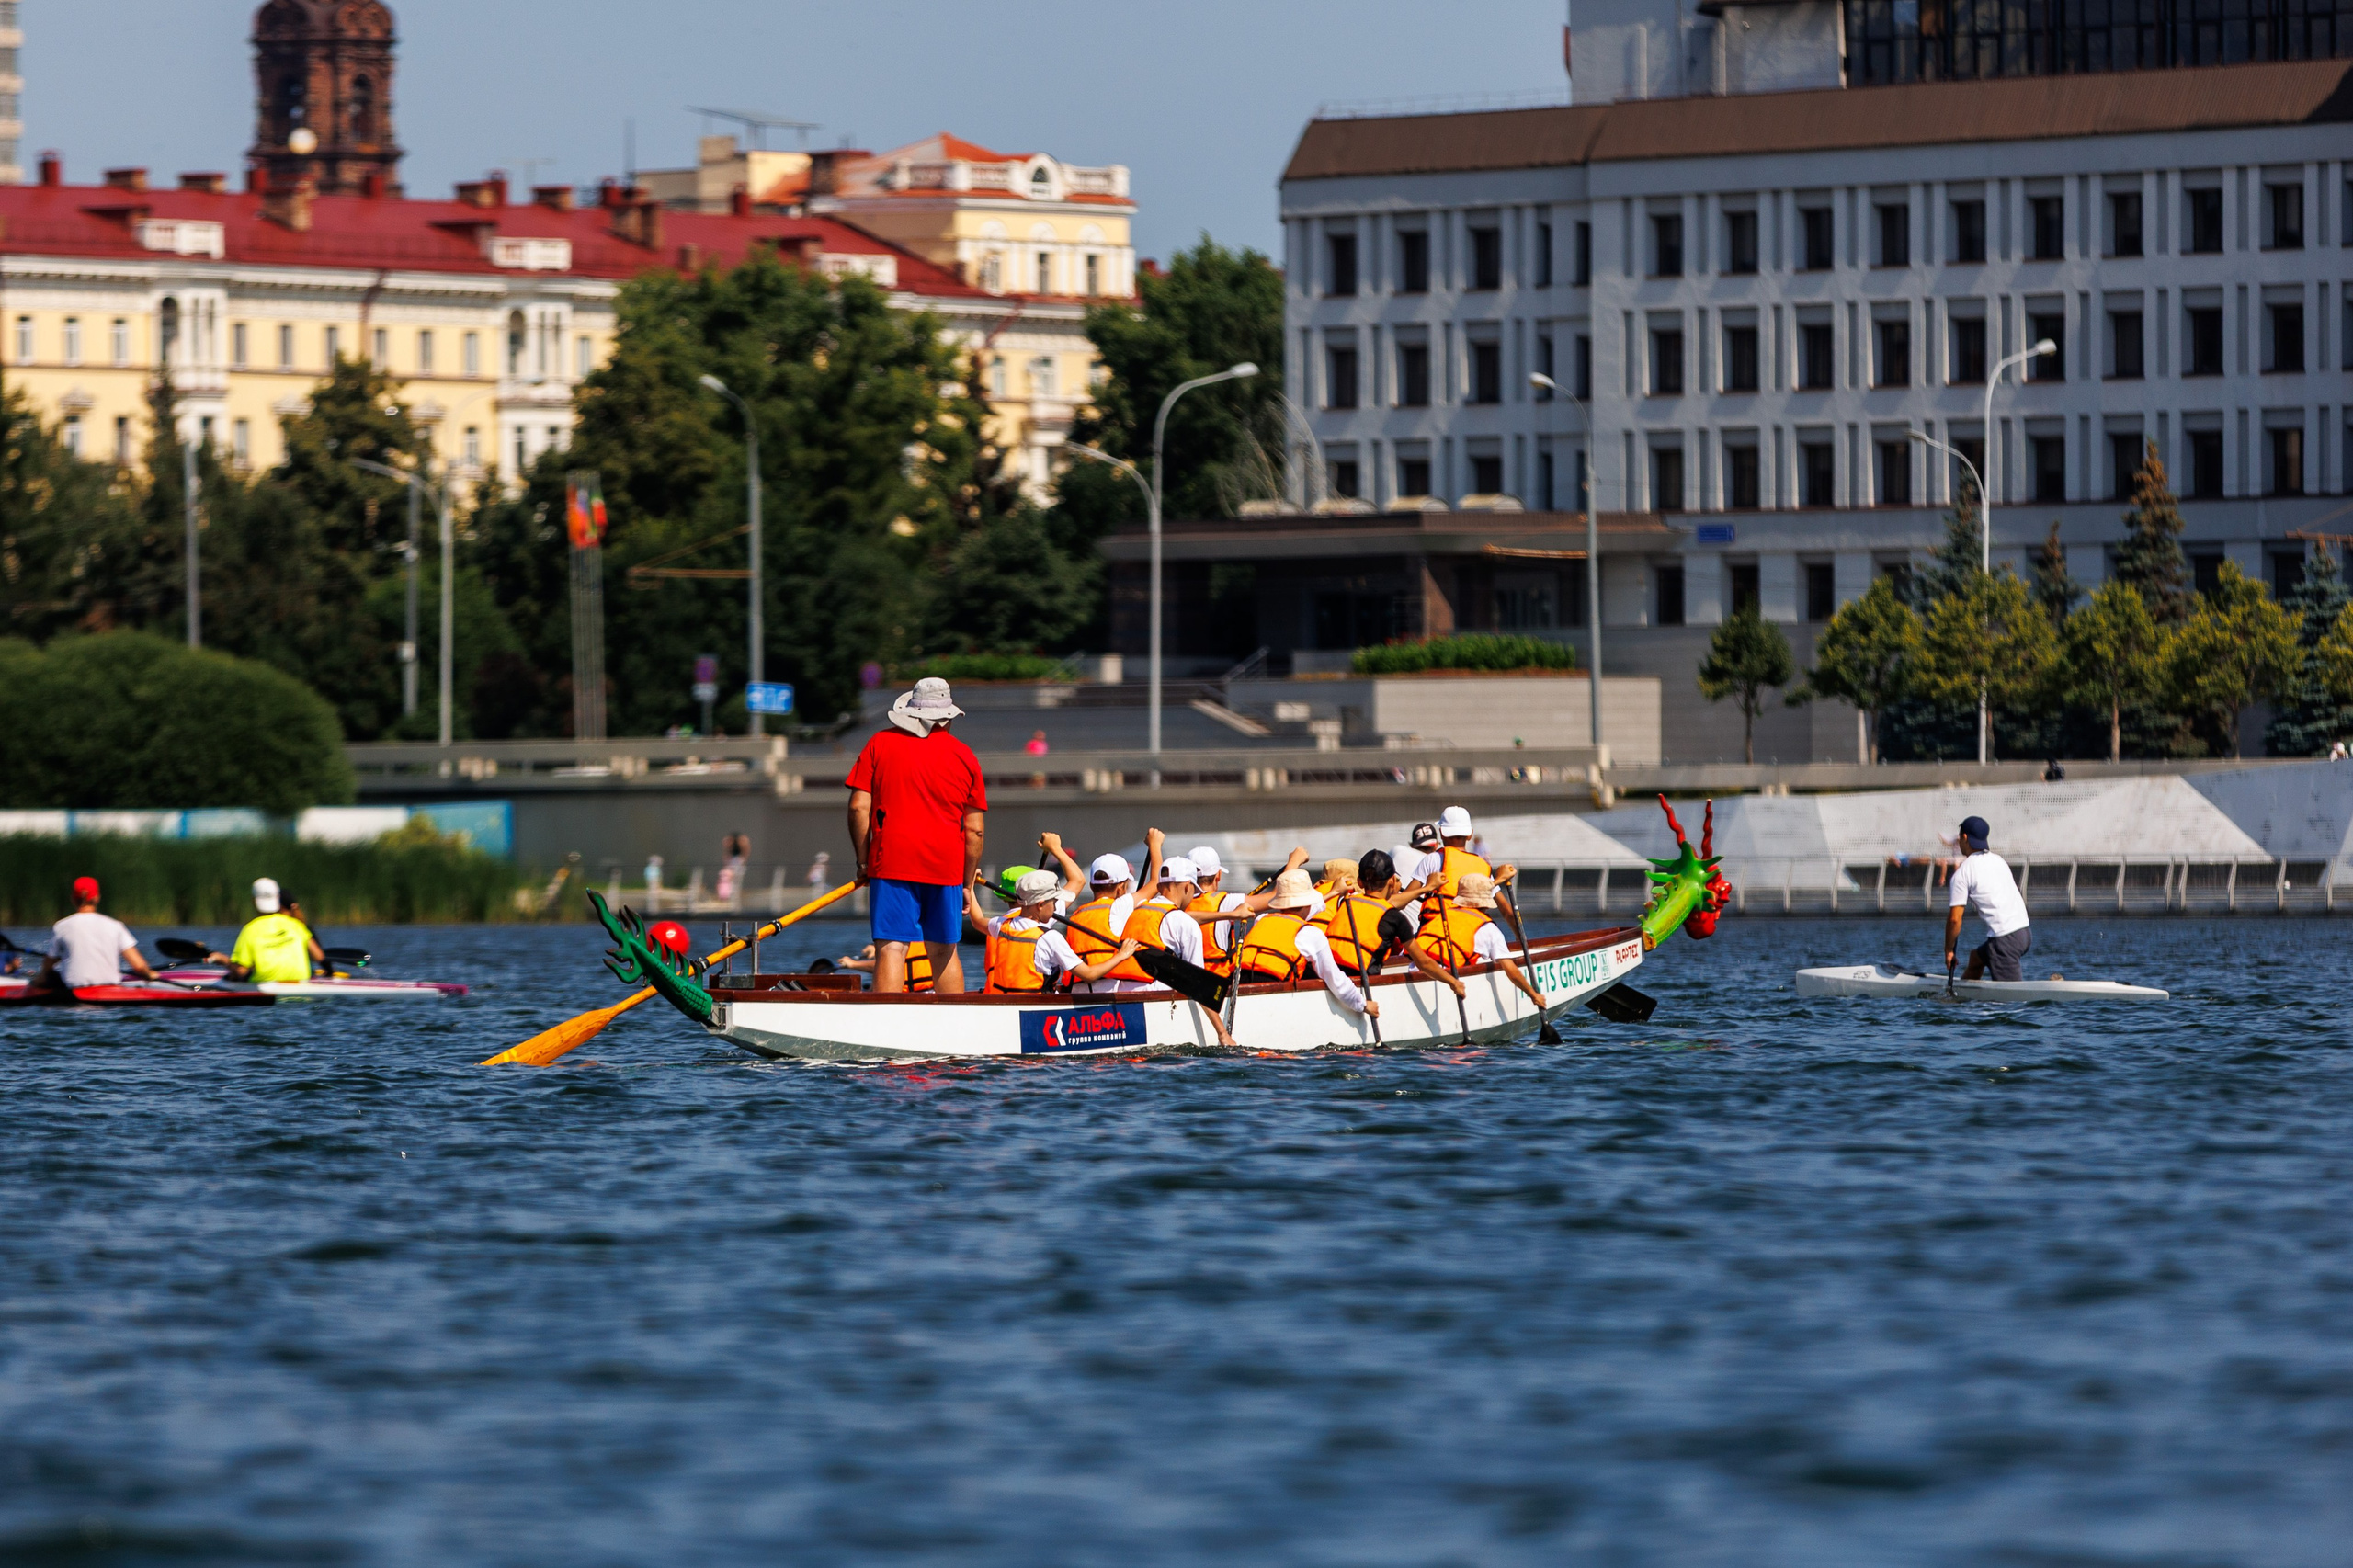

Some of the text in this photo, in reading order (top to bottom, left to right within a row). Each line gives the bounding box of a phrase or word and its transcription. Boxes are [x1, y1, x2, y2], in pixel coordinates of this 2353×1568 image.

[1415, 825, 1433, 840] 35
[1520, 962, 1556, 998] FIS
[1559, 953, 1598, 988] GROUP
[1068, 1011, 1126, 1034] АЛЬФА
[1068, 1031, 1127, 1045] группа компаний
